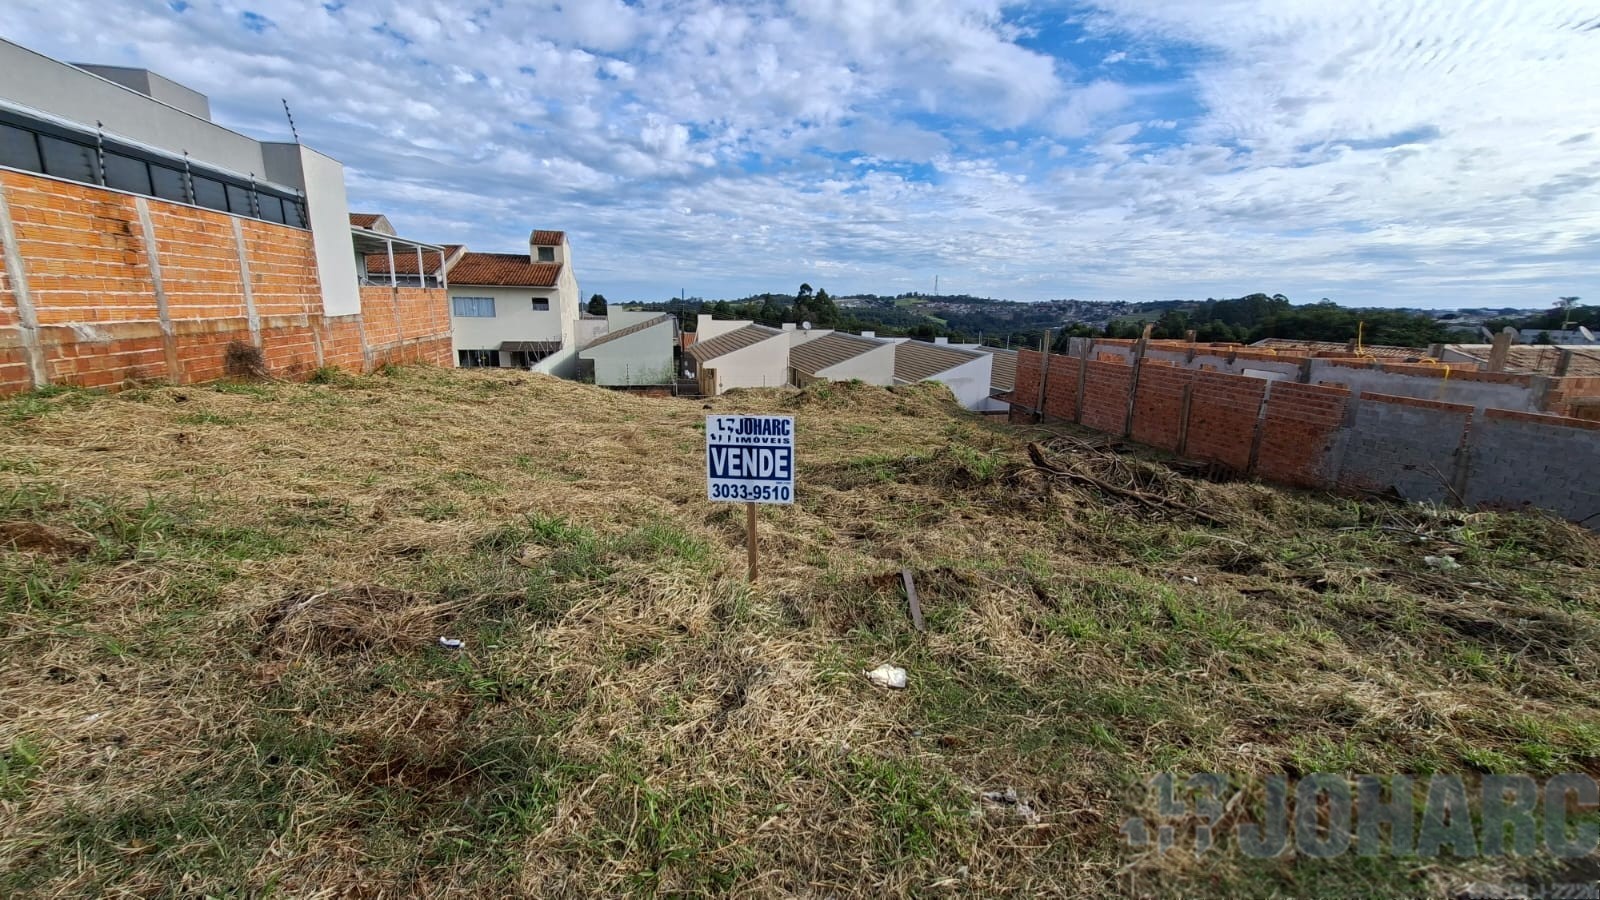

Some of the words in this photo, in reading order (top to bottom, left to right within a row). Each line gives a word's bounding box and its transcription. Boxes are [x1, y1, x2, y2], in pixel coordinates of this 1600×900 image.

[735, 418, 790, 436] JOHARC
[711, 447, 788, 478] VENDE
[712, 483, 789, 500] 3033-9510
